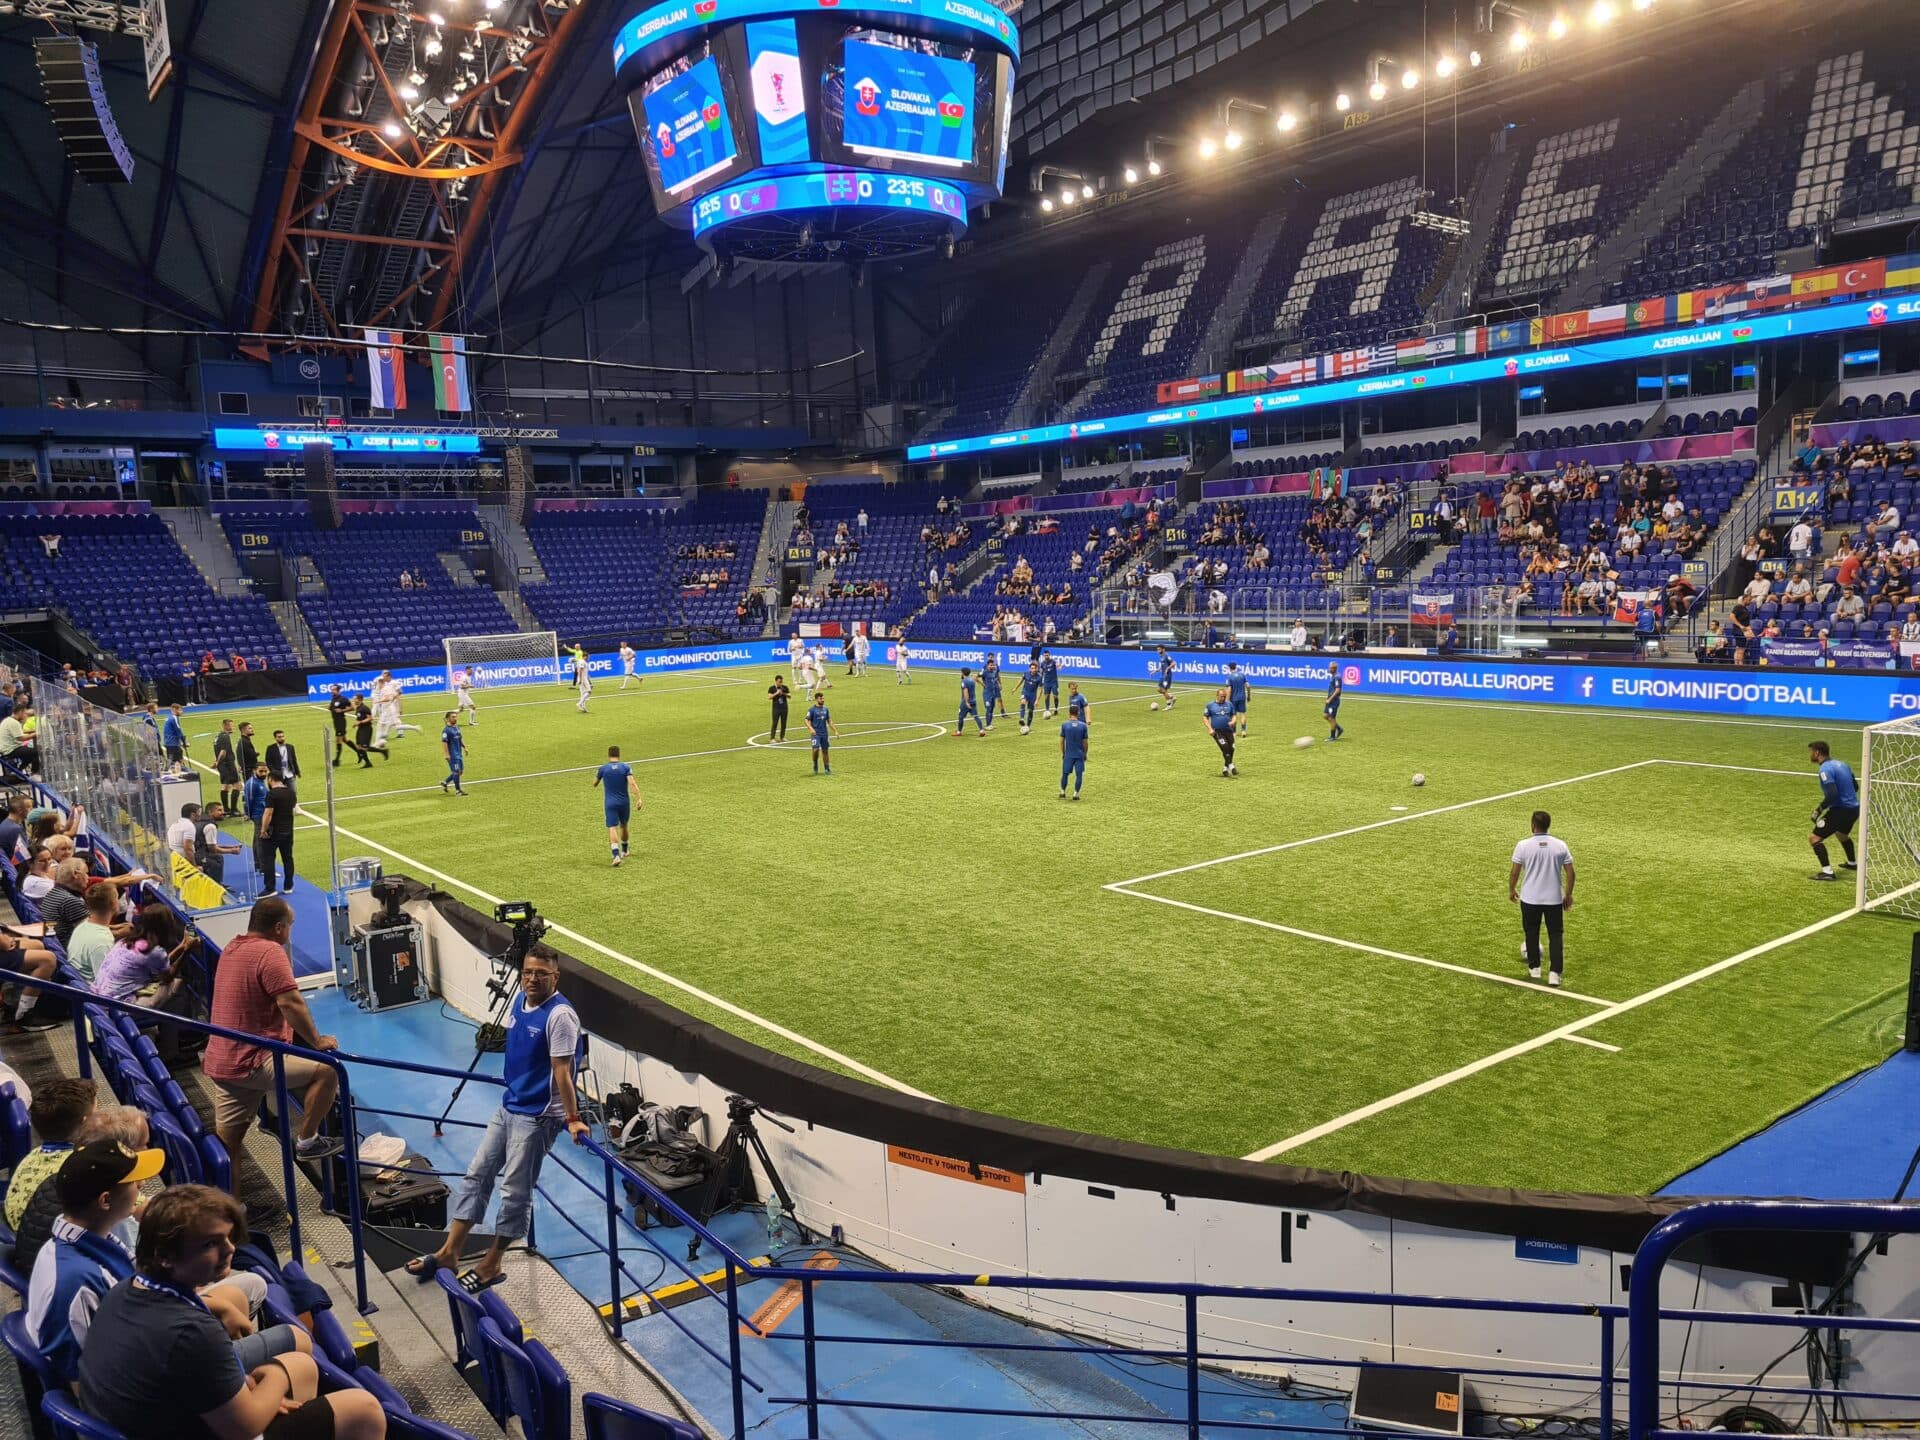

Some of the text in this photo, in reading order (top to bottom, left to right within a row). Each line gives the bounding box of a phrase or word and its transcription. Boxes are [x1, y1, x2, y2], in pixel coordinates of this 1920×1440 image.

[637, 8, 687, 39] AZERBAIJAN
[944, 1, 996, 28] AZERBAIJAN
[890, 88, 931, 104] SLOVAKIA
[884, 101, 936, 117] AZERBAIJAN
[858, 180, 872, 197] 0
[887, 178, 924, 197] 23:15
[934, 187, 943, 206] 0
[699, 194, 721, 218] 23:15
[730, 193, 741, 210] 0
[1653, 330, 1721, 350] AZERBAIJAN
[1525, 352, 1570, 368] SLOVAKIA
[1358, 378, 1405, 393] AZERBAIJAN
[242, 534, 269, 546] B19
[644, 650, 752, 668] EUROMINIFOOTBALL
[1184, 661, 1204, 674] NÁS
[1206, 665, 1218, 675] NA
[1368, 669, 1555, 691] MINIFOOTBALLEUROPE
[1611, 677, 1837, 706] EUROMINIFOOTBALL
[898, 1150, 933, 1166] NESTOJTE
[934, 1158, 941, 1167] V
[941, 1160, 966, 1173] TOMTO
